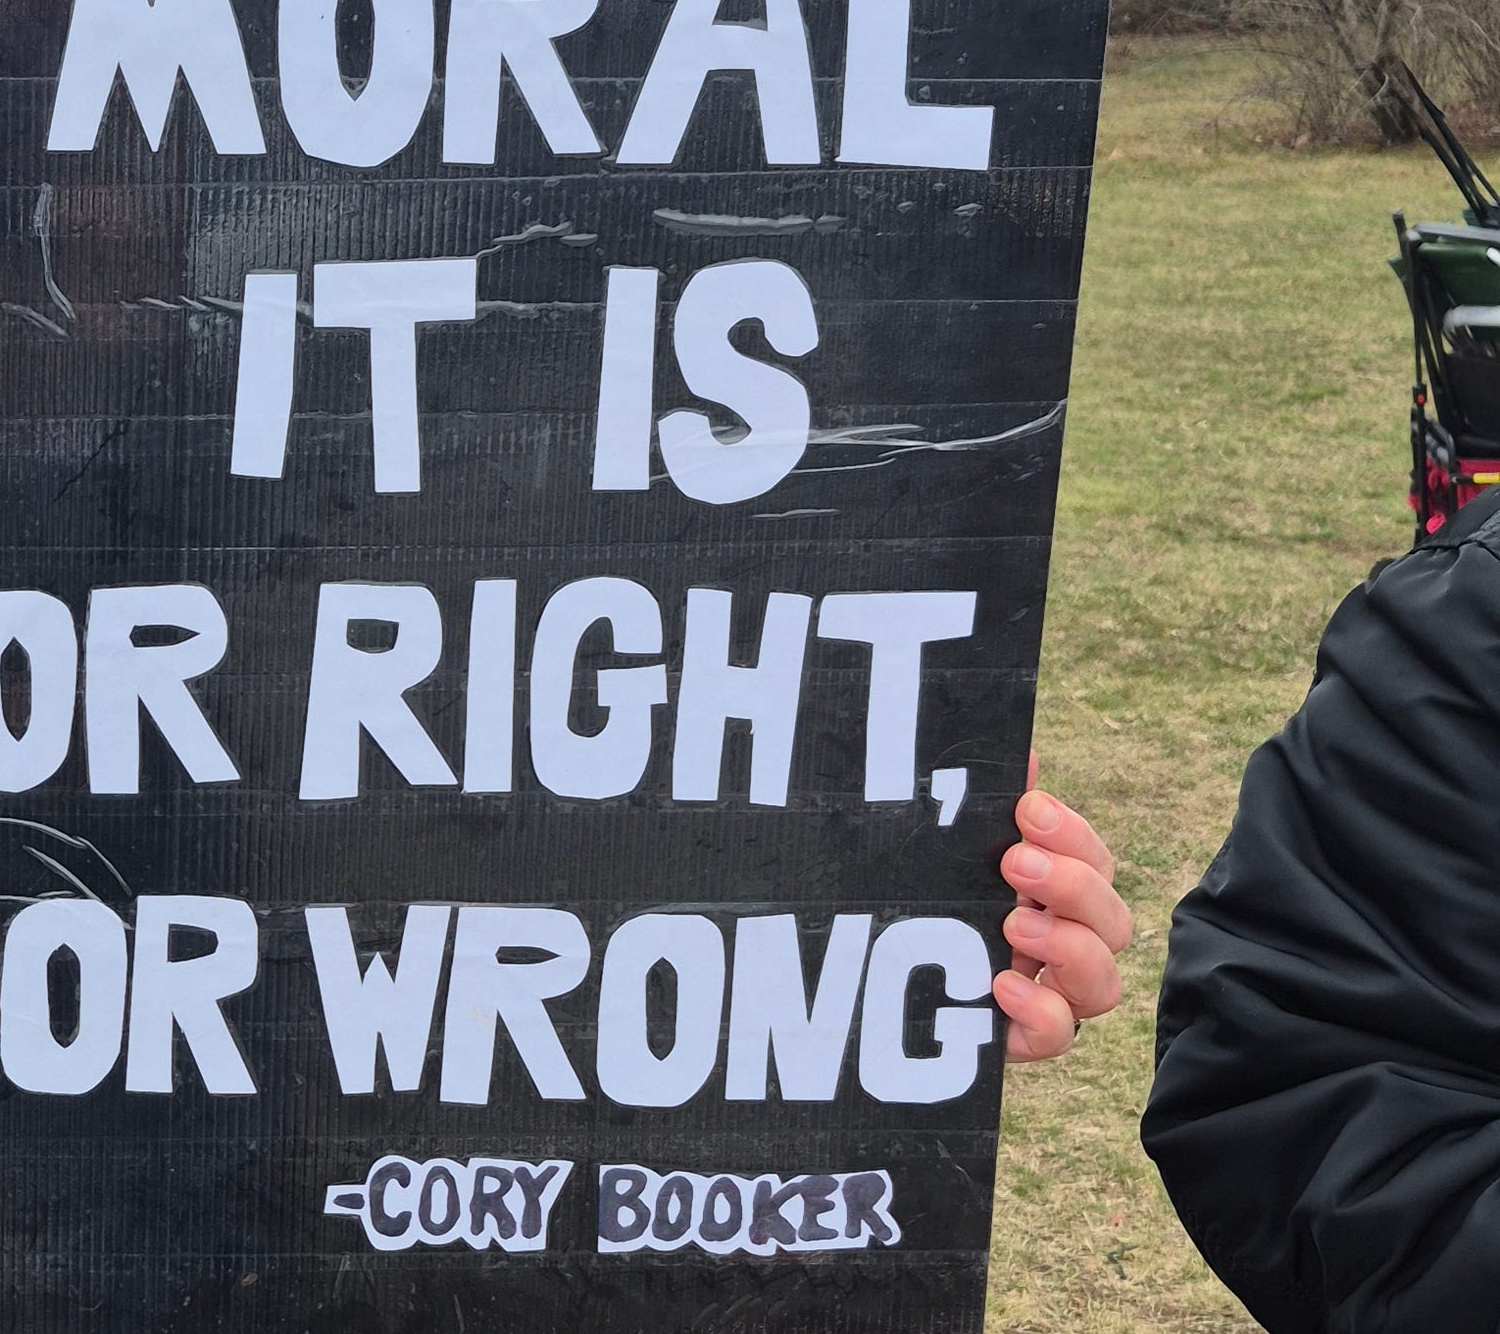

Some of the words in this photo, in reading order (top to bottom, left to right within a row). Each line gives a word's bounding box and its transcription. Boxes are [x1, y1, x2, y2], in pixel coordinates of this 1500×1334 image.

[231, 259, 477, 493] IT
[592, 261, 819, 505] IS
[299, 577, 978, 827] RIGHT,
[0, 895, 259, 1095] OR
[305, 903, 995, 1108] WRONG
[332, 1160, 562, 1241] -CORY
[598, 1167, 896, 1244] BOOKER
